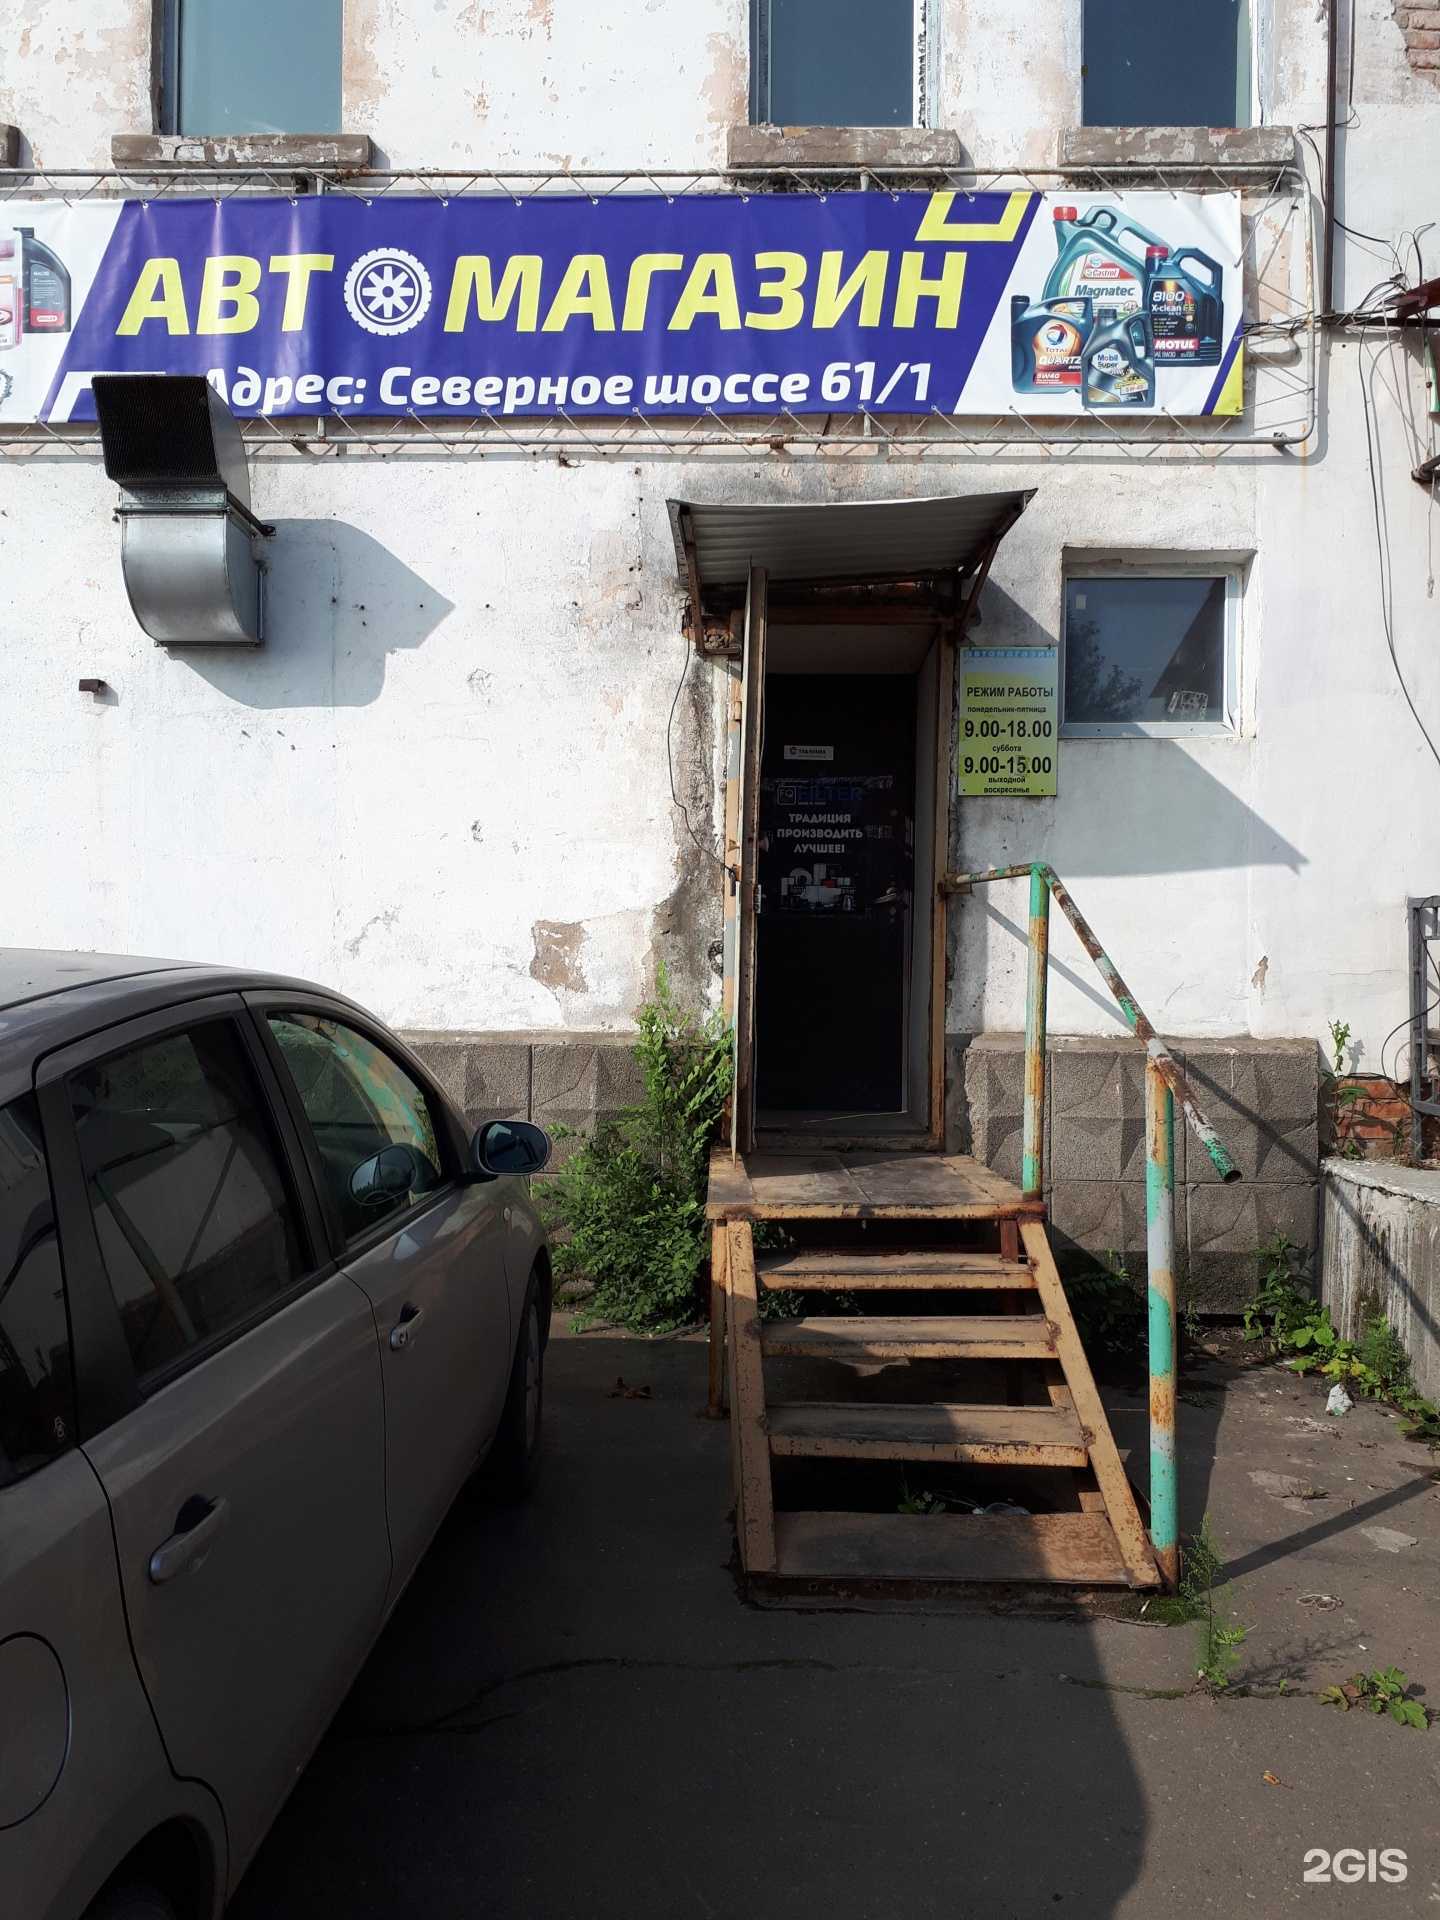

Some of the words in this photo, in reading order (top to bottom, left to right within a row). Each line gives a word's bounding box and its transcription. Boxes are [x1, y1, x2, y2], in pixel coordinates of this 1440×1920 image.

[1075, 284, 1136, 299] Magnatec
[1153, 291, 1186, 302] 8100
[1154, 340, 1196, 349] MOTUL
[1039, 356, 1082, 366] QUARTZ
[1097, 361, 1118, 369] Super
[205, 366, 367, 415] Адрес:
[379, 366, 634, 414] Северное
[643, 375, 810, 405] шоссе
[821, 361, 932, 404] 61/1
[967, 687, 1005, 697] РЕЖИМ
[1008, 687, 1053, 697] РАБОТЫ
[964, 720, 1052, 738] 9.00-18.00
[992, 744, 1021, 753] суббота
[964, 756, 1052, 774] 9.00-15.00
[789, 813, 851, 824] ТРАДИЦИЯ
[777, 828, 863, 839] ПРОИЗВОДИТЬ
[793, 843, 845, 853] ЛУЧШЕЕ!
